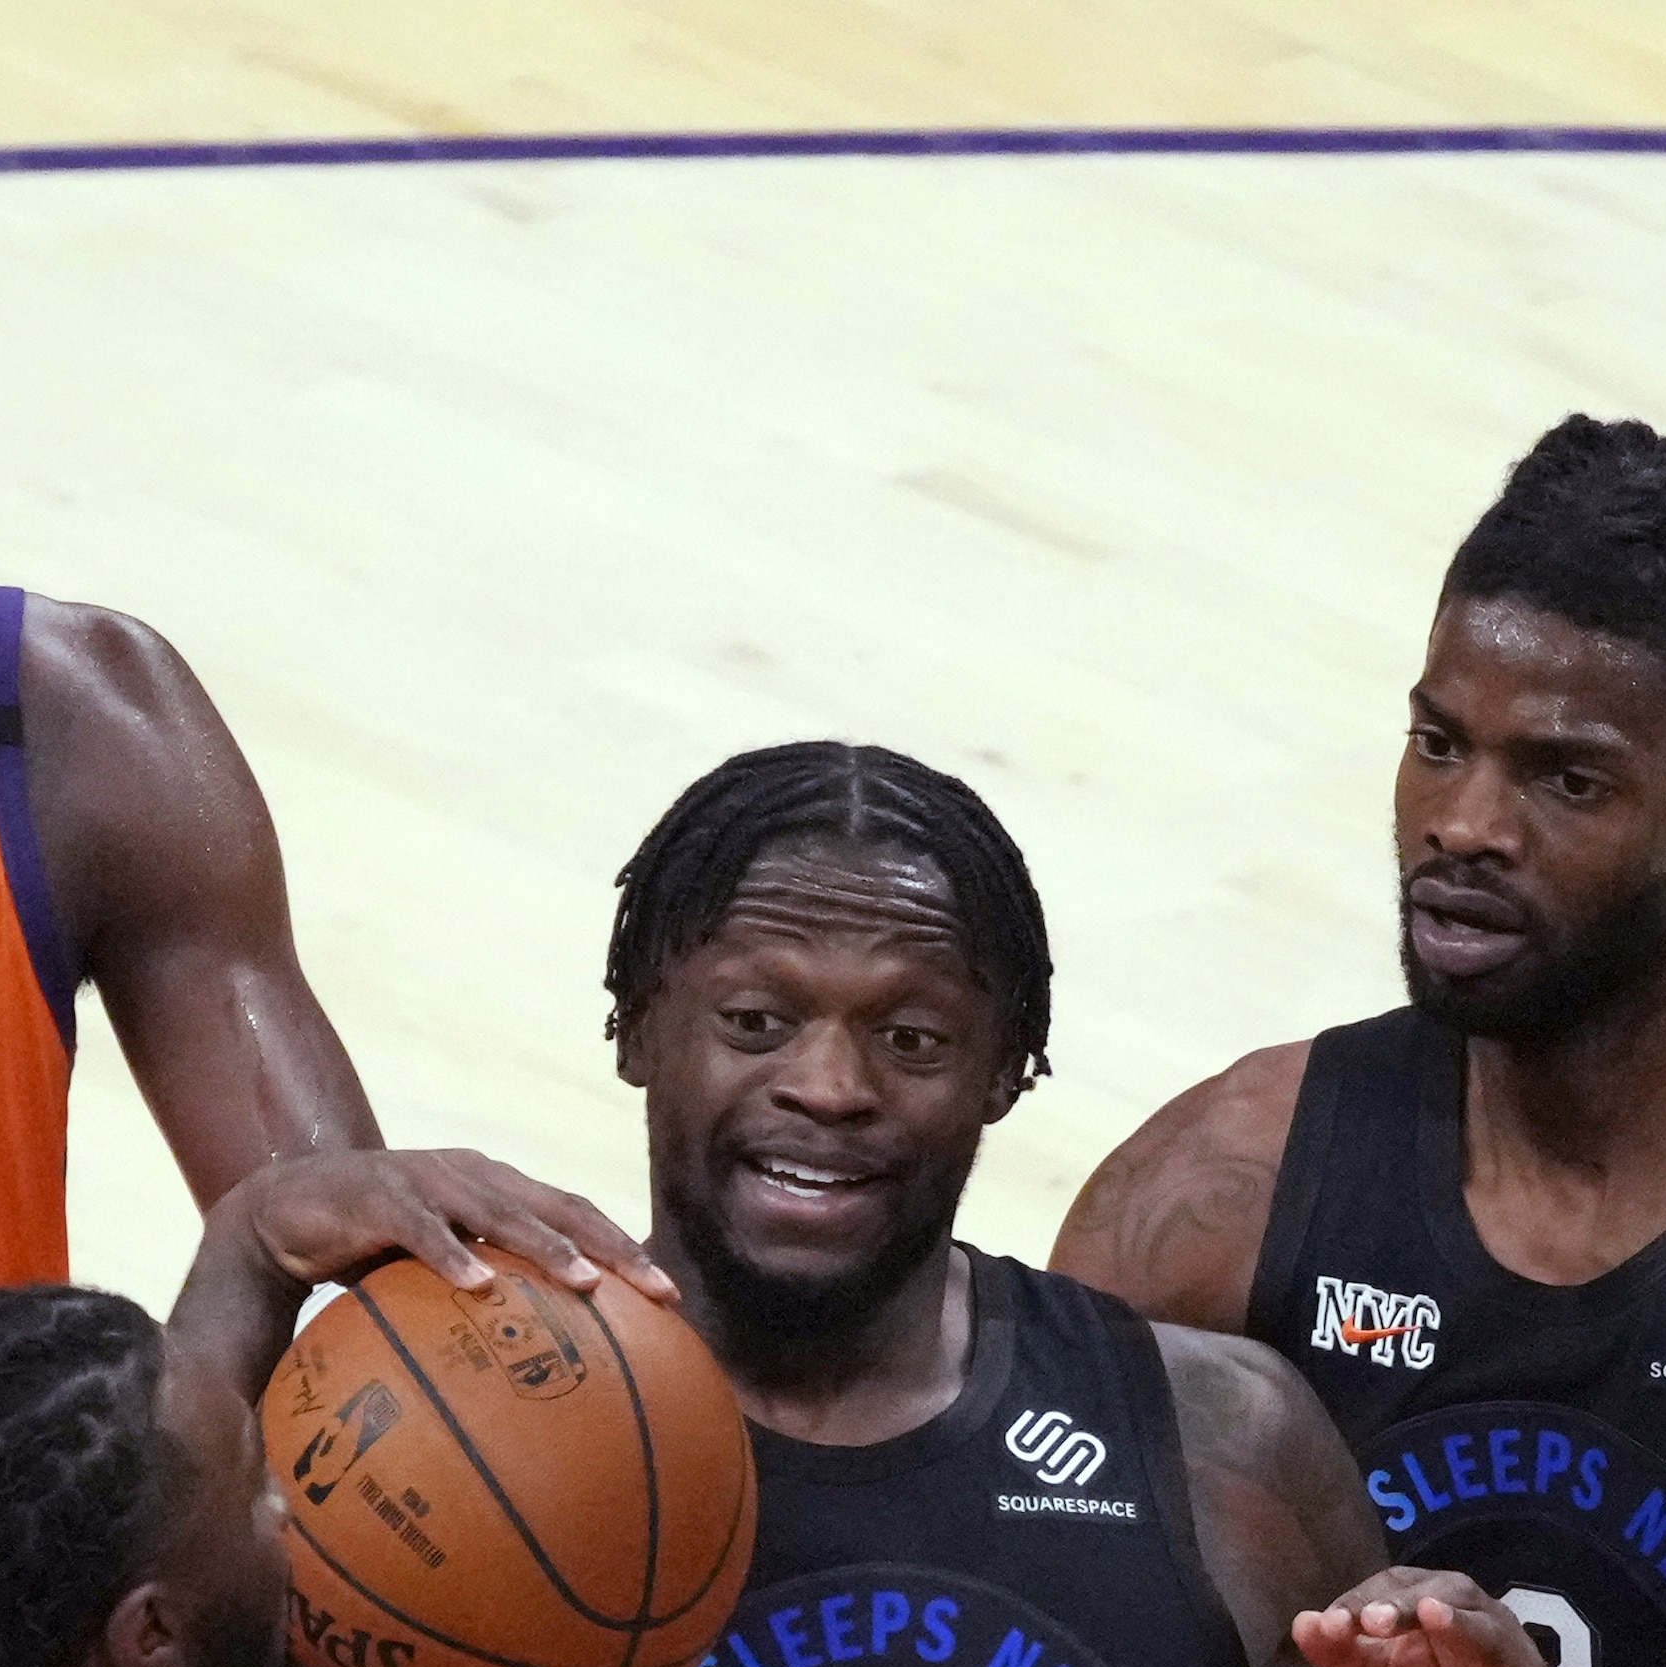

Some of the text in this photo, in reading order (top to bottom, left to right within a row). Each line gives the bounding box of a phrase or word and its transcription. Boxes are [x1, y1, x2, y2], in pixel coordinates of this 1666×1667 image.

[1311, 1275, 1441, 1369] NYC
[998, 1494, 1137, 1519] SQUARESPACE
[1367, 1428, 1609, 1532] SLEEPS
